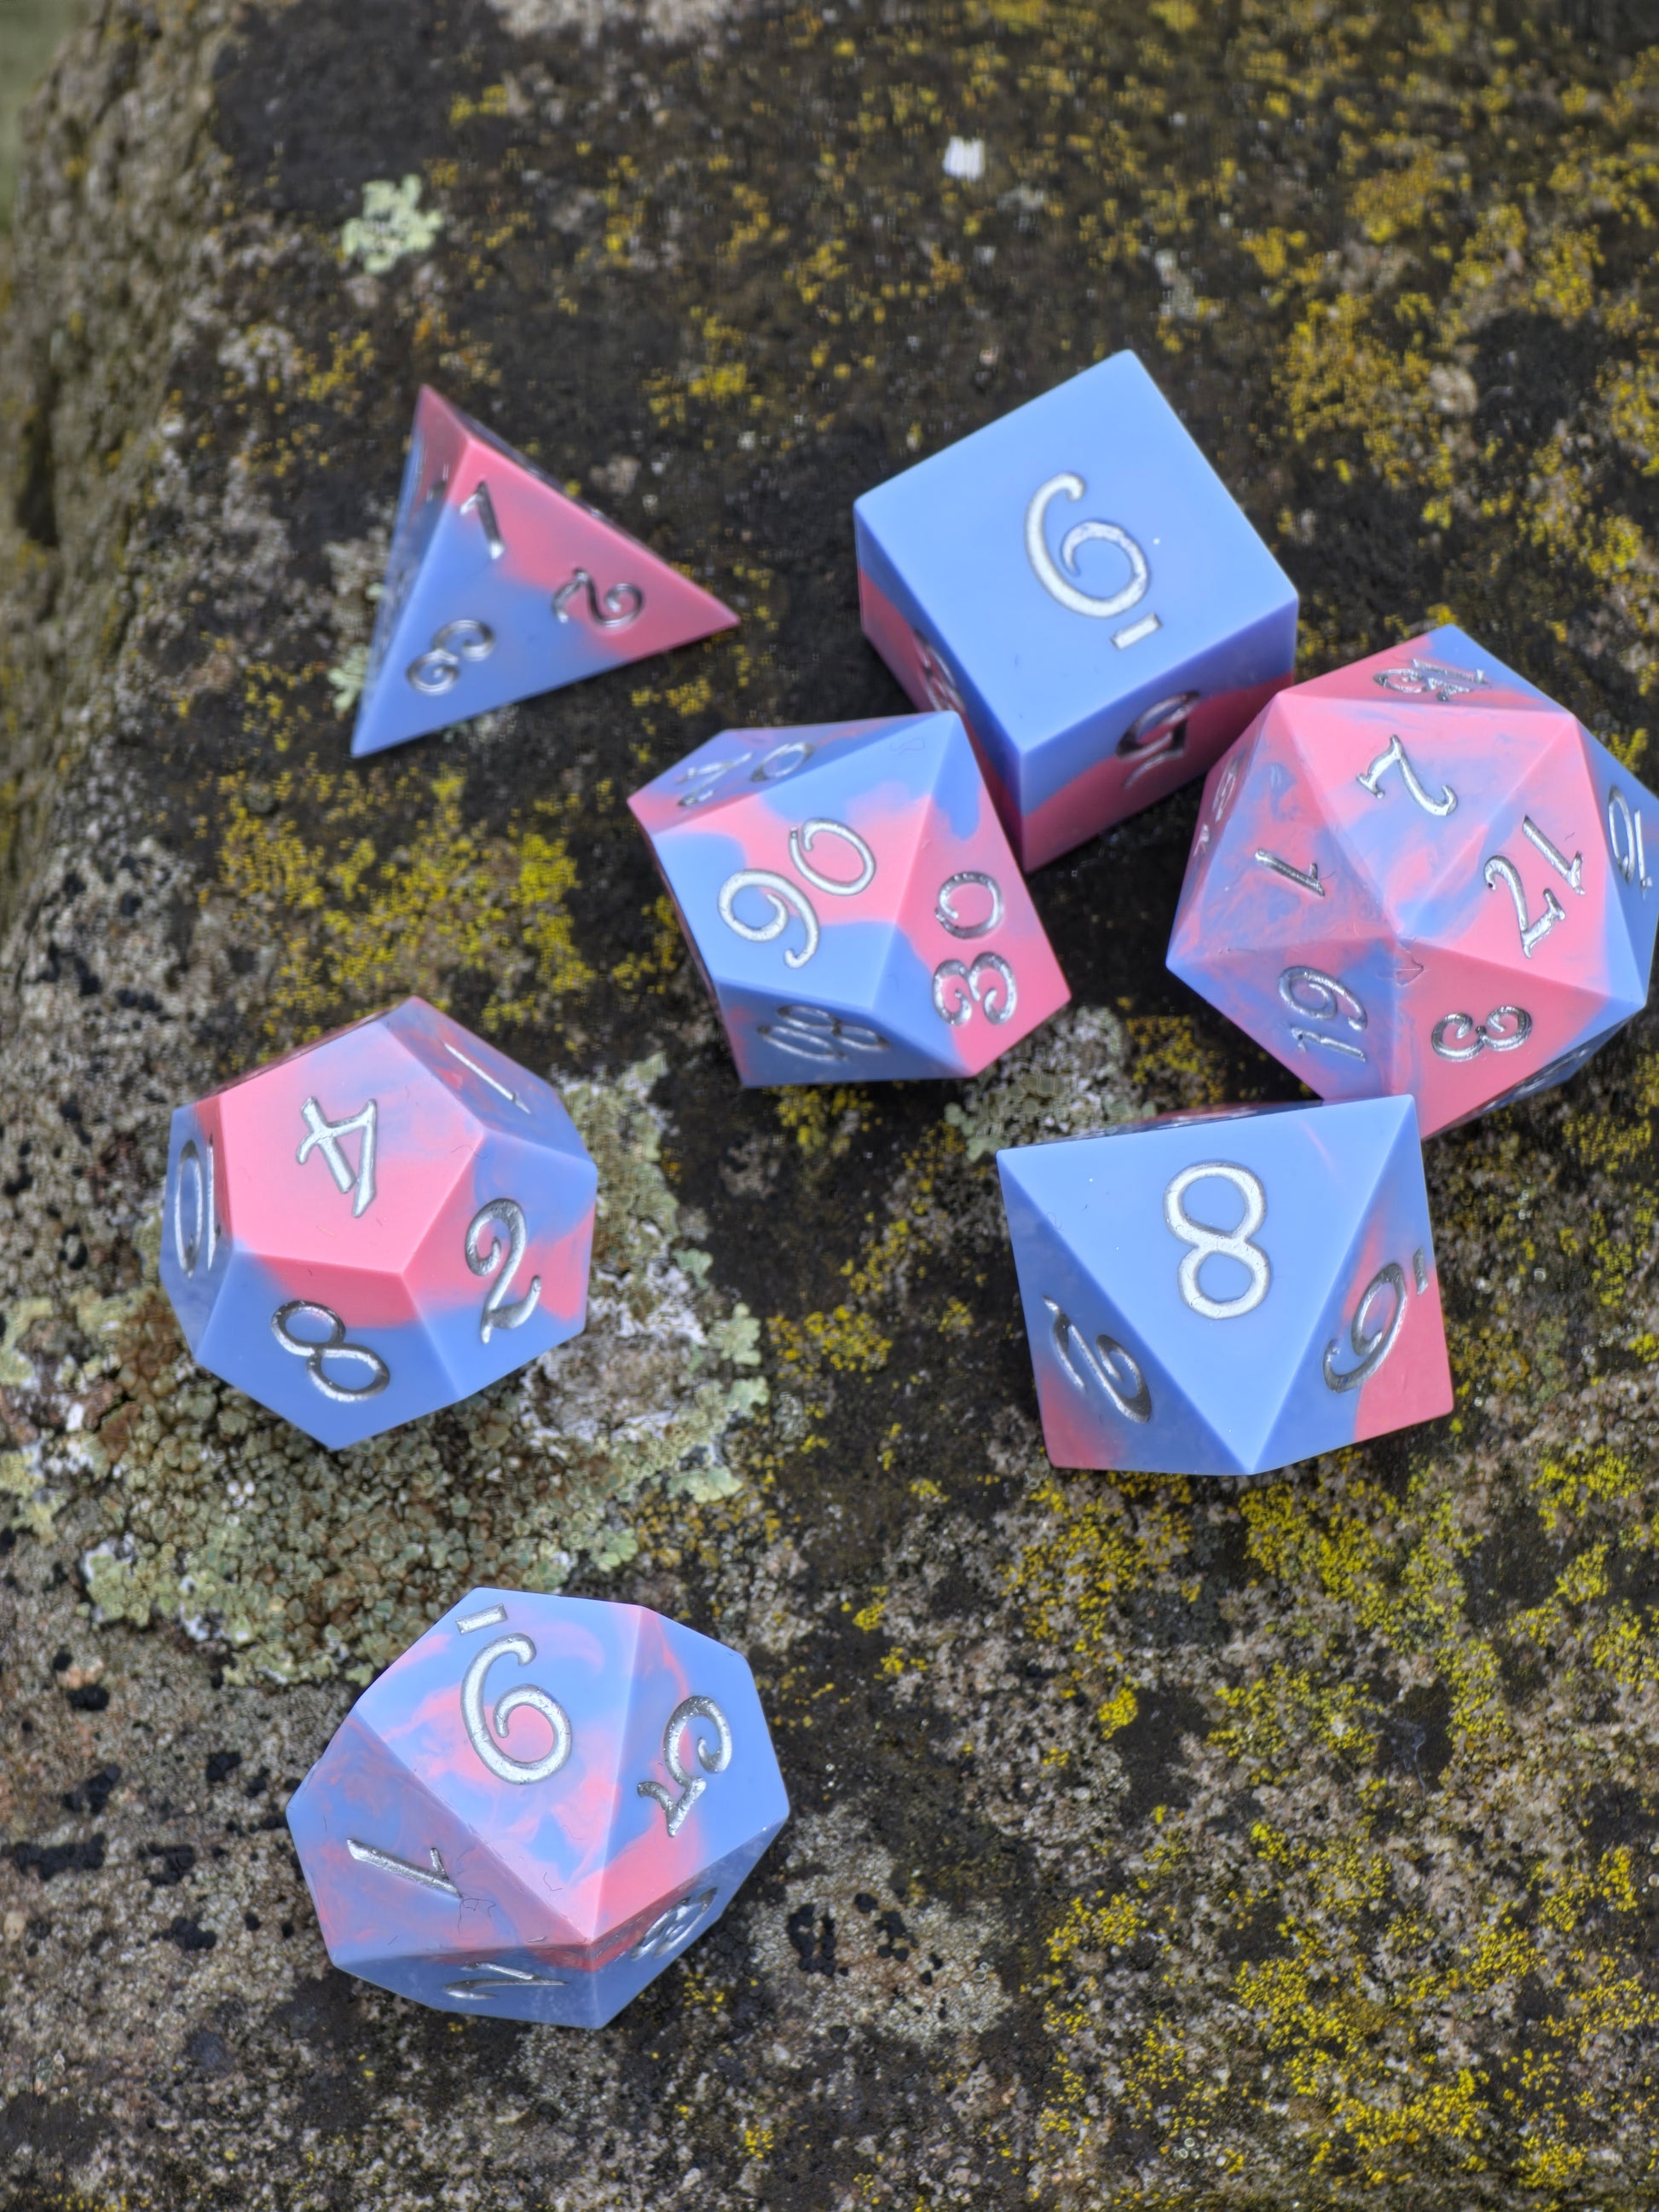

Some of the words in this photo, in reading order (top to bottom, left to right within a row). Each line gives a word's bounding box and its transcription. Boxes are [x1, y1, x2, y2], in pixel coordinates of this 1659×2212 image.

[460, 480, 505, 559] 1
[1023, 471, 1163, 650] 6
[406, 619, 495, 696] 3
[552, 567, 646, 627] 2
[717, 817, 876, 968] 90
[1255, 848, 1326, 898] 1
[932, 870, 1019, 1025] 30
[1279, 965, 1367, 1062] 19
[296, 1096, 378, 1217] 4
[465, 1198, 542, 1344] 2
[1163, 1160, 1271, 1320] 8
[271, 1299, 390, 1402] 8
[1043, 1294, 1152, 1424] 2
[636, 1695, 733, 1838] 5
[346, 1837, 463, 1899] 1
